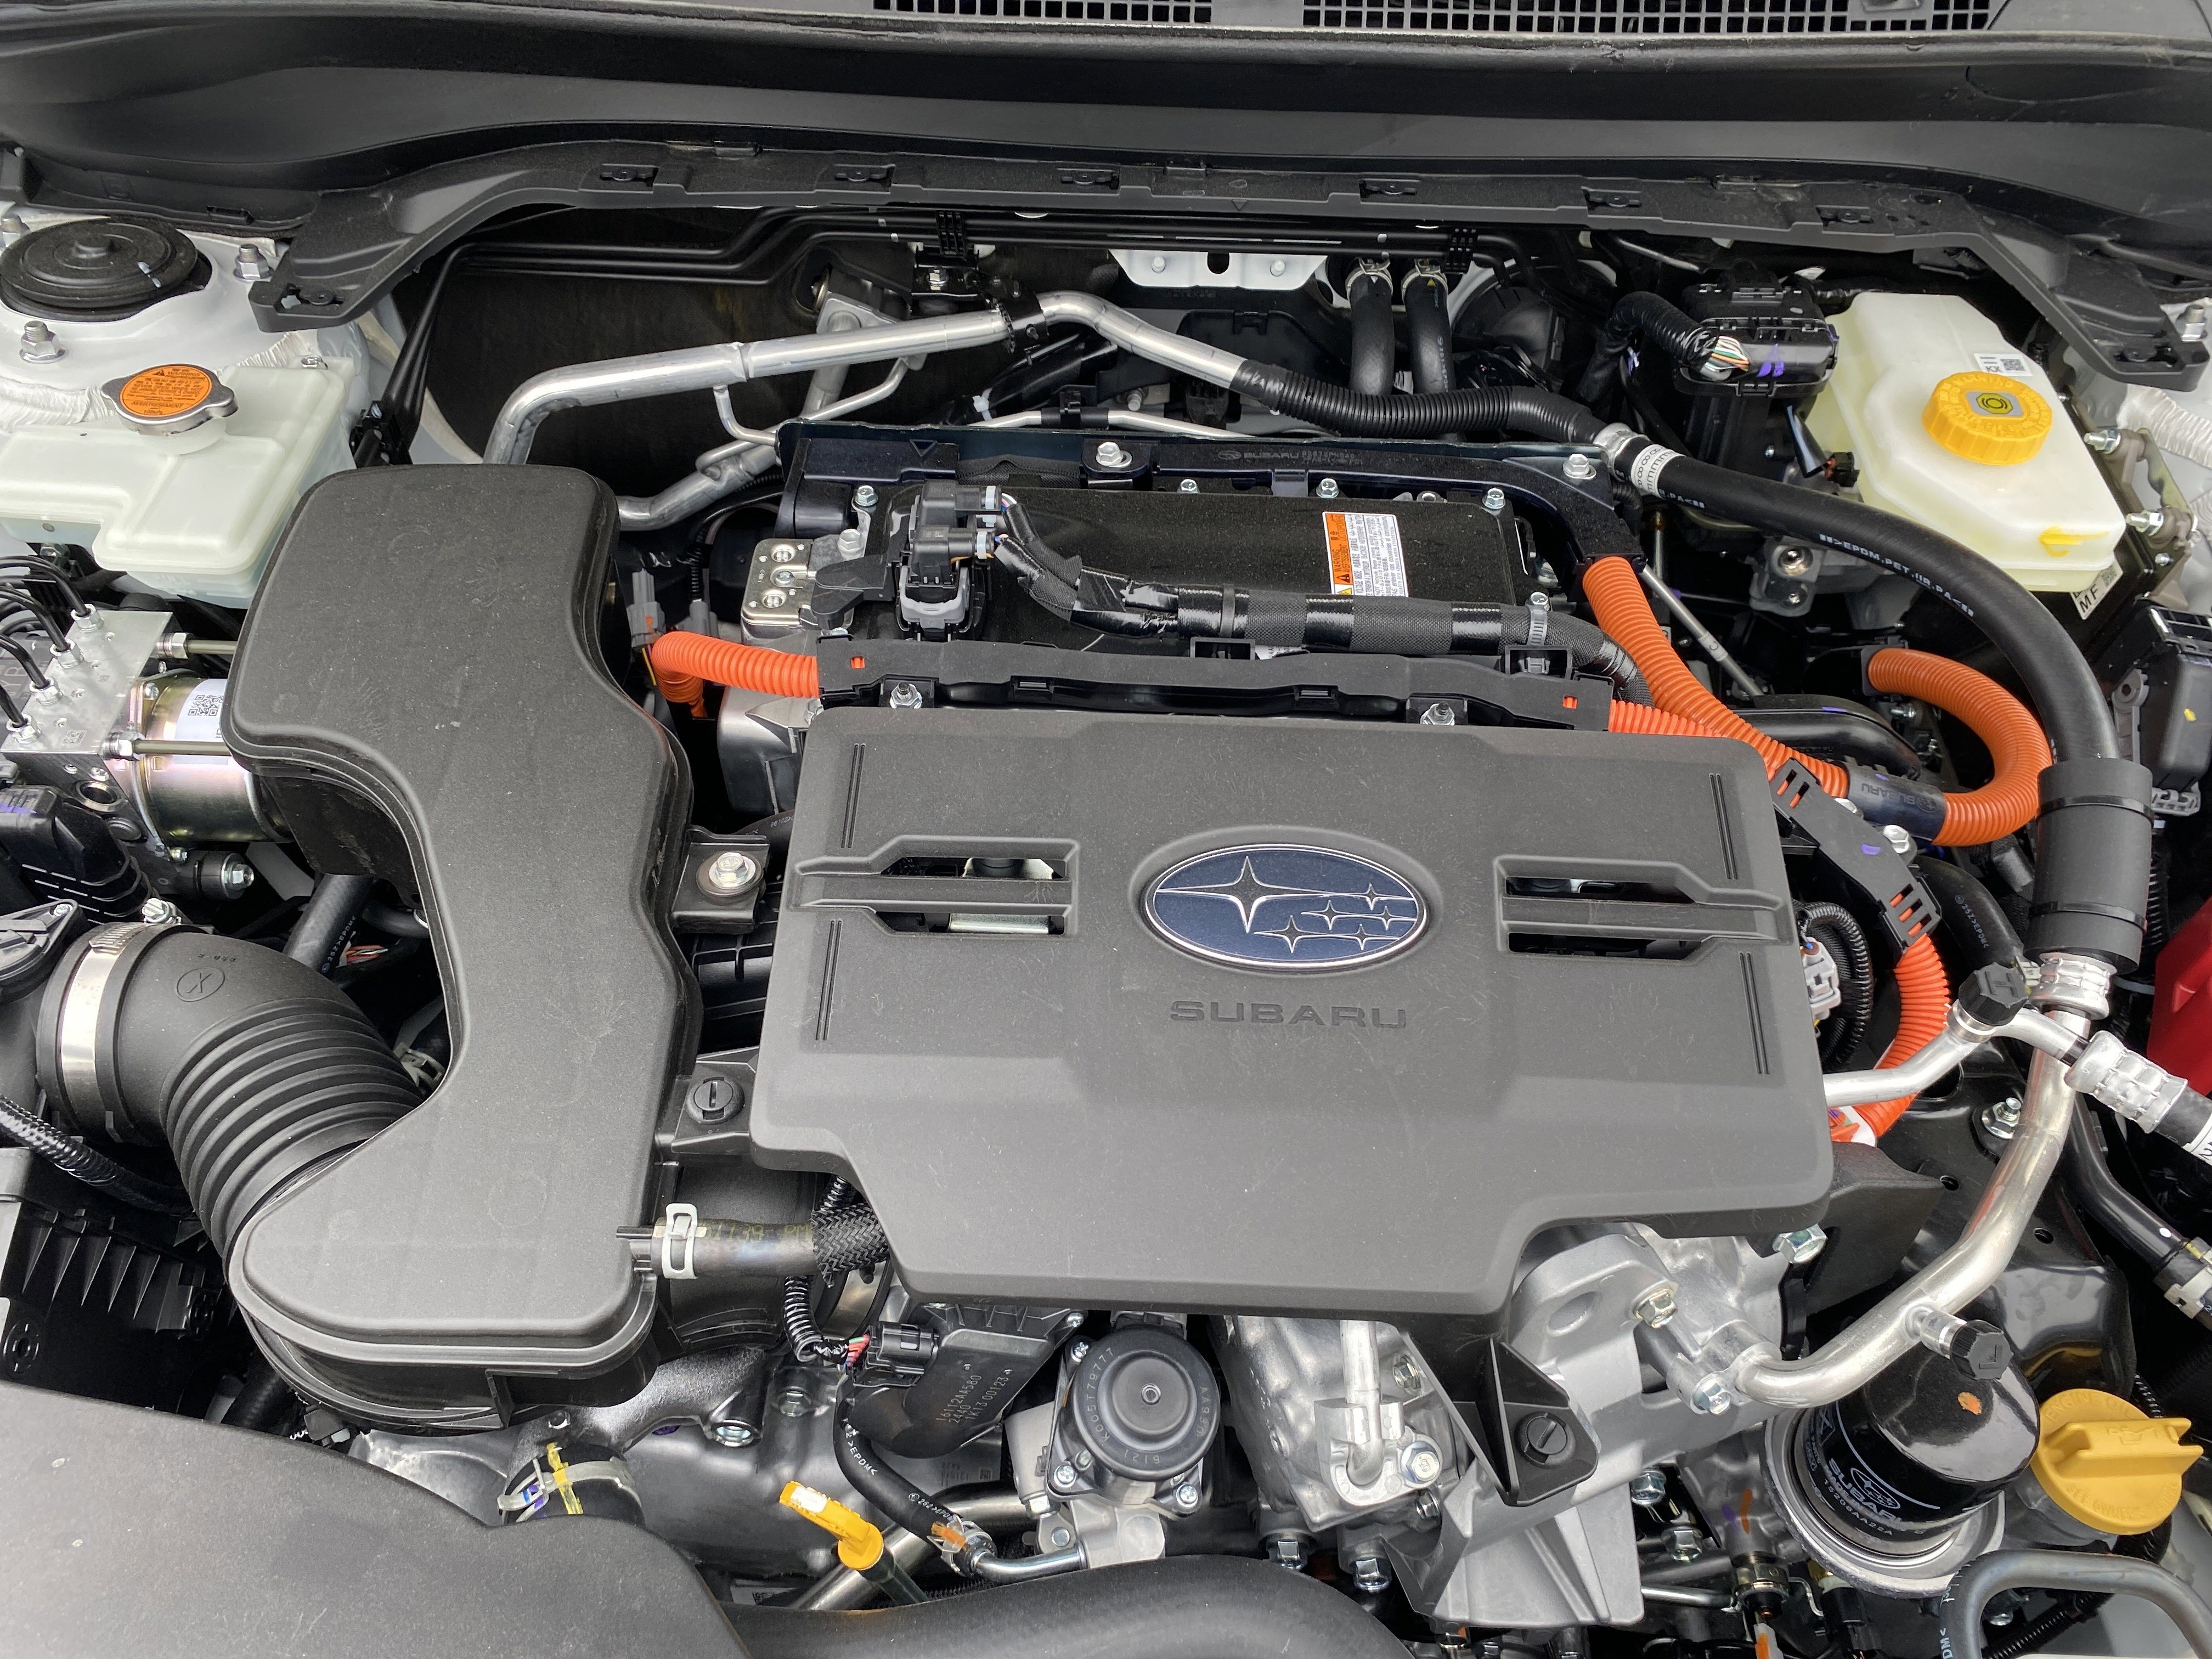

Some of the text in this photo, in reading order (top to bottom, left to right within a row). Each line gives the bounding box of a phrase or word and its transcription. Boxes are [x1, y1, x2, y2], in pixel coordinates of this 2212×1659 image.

[1332, 549, 1342, 572] WARNING
[1170, 1001, 1406, 1028] SUBARU
[2044, 1390, 2102, 1423] ENGINE
